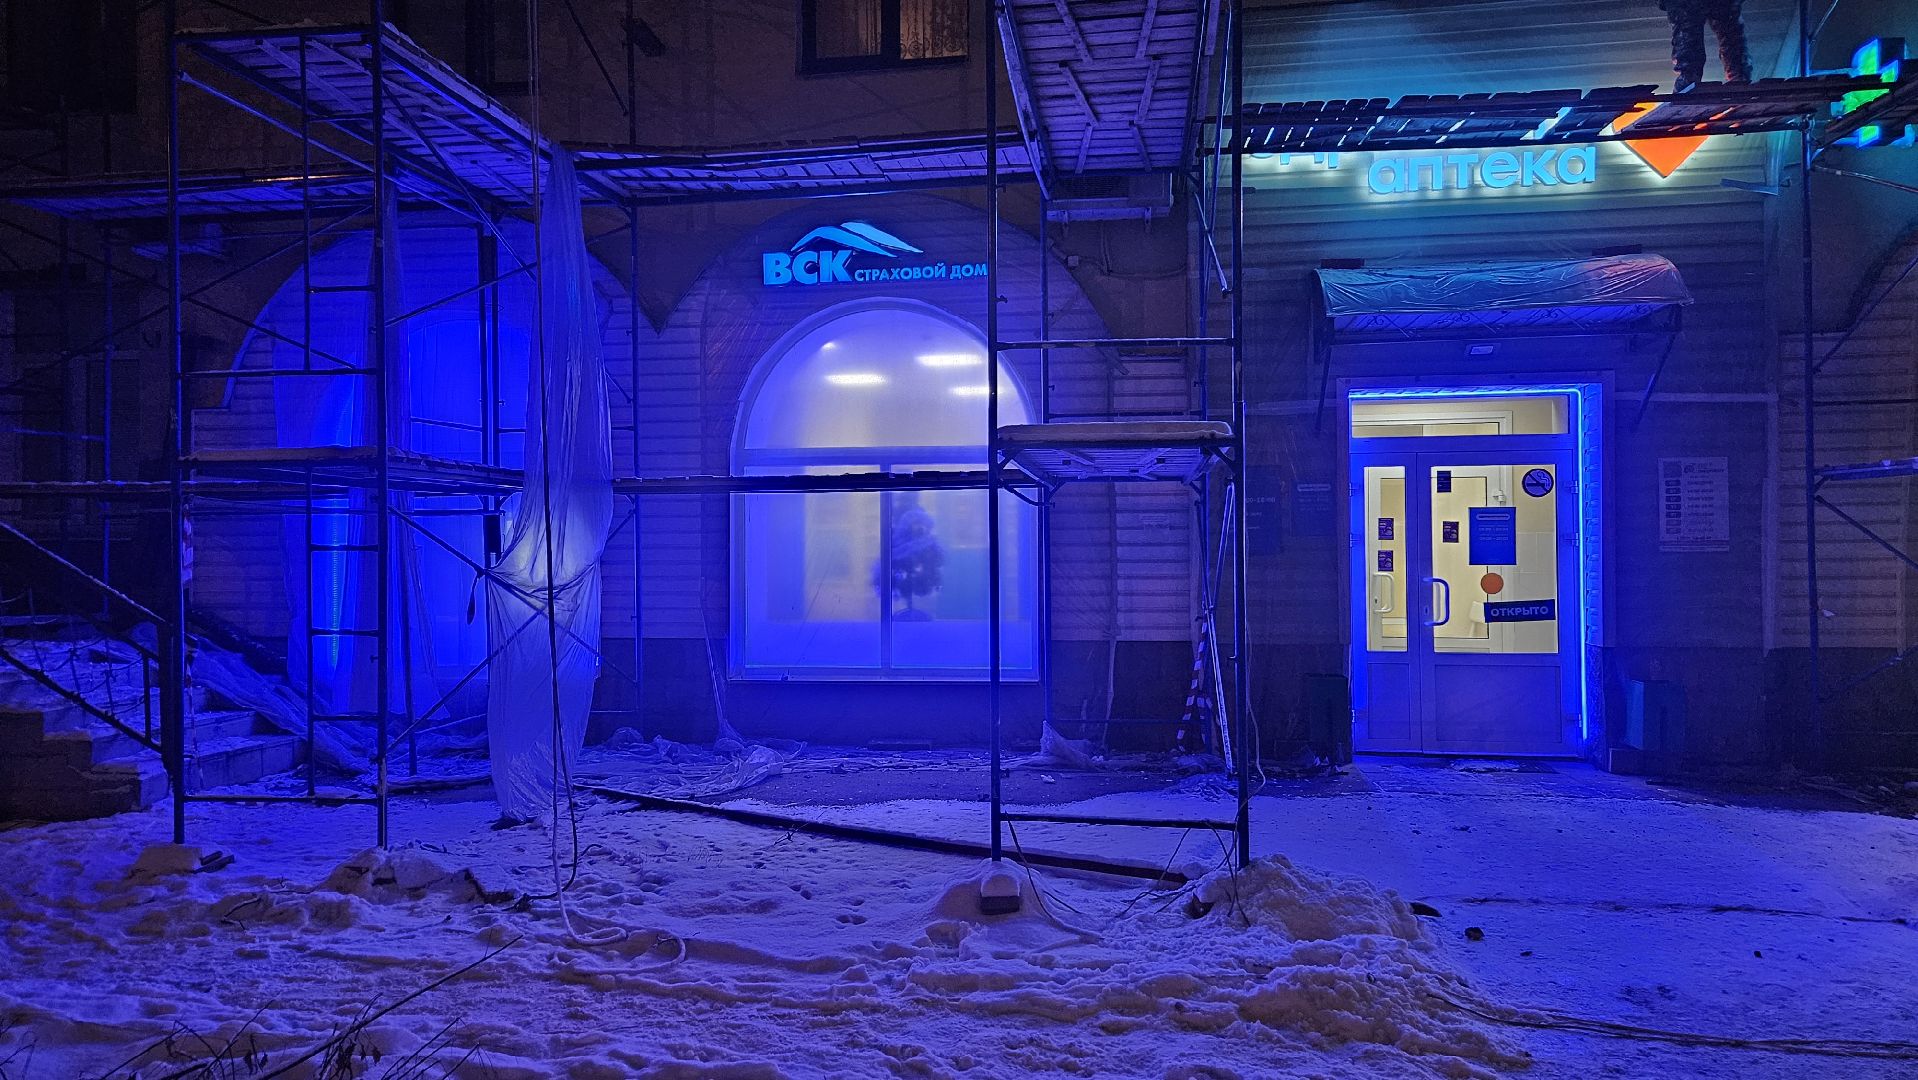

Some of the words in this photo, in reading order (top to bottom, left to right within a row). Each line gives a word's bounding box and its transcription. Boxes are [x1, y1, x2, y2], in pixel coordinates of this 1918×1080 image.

[1367, 146, 1596, 196] аптека
[762, 249, 853, 286] ВСК
[854, 262, 947, 282] СТРАХОВОЙ
[950, 263, 988, 280] ДОМ
[1490, 605, 1550, 617] ОТКРЫТО
